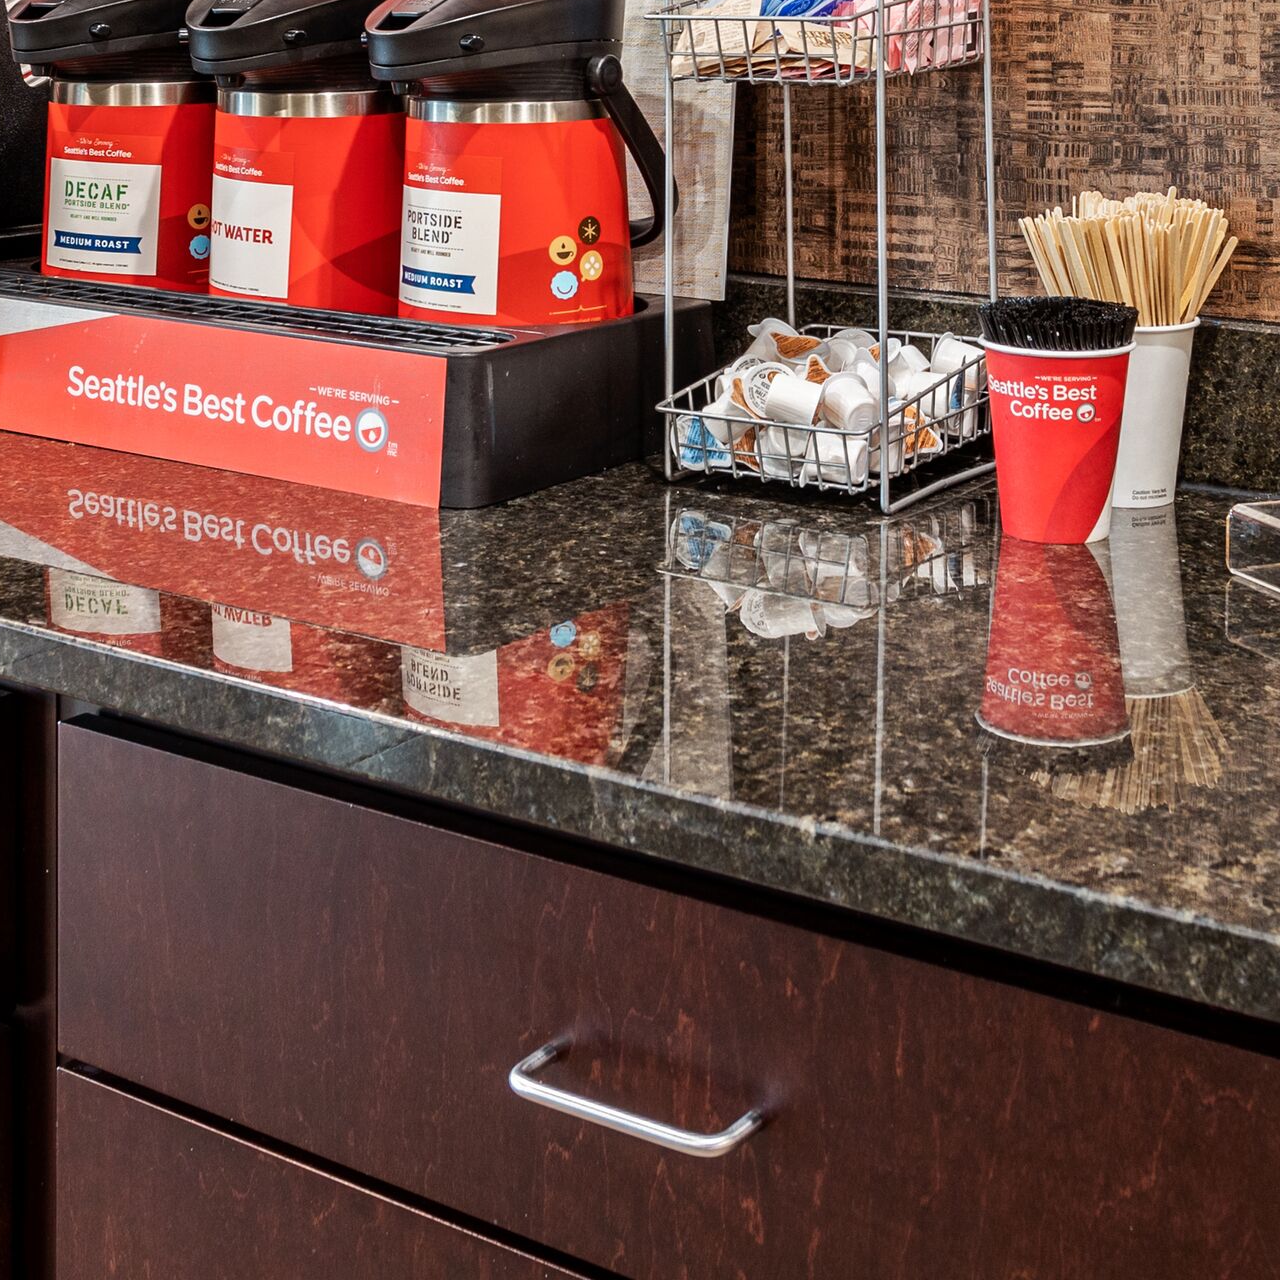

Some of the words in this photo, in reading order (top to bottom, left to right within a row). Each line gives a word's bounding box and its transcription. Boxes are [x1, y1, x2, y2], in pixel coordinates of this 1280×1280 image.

[89, 148, 105, 157] Best
[106, 149, 132, 158] Coffee
[241, 166, 263, 176] Coffee
[65, 180, 128, 201] DECAF
[440, 176, 465, 186] Coffee
[64, 198, 97, 208] PORTSIDE
[407, 209, 462, 229] PORTSIDE
[59, 235, 92, 246] MEDIUM
[94, 239, 130, 249] ROAST
[224, 222, 273, 244] WATER
[411, 226, 450, 244] BLEND
[404, 271, 428, 284] MEDIUM
[430, 276, 463, 288] ROAST
[317, 385, 348, 401] WE'RE
[348, 390, 391, 406] SERVING
[988, 373, 1048, 400] Seattle's
[1053, 384, 1097, 401] Best
[66, 365, 178, 412] Seattle's
[183, 383, 246, 425] Best
[250, 394, 351, 441] Coffee
[1010, 400, 1073, 421] Coffee
